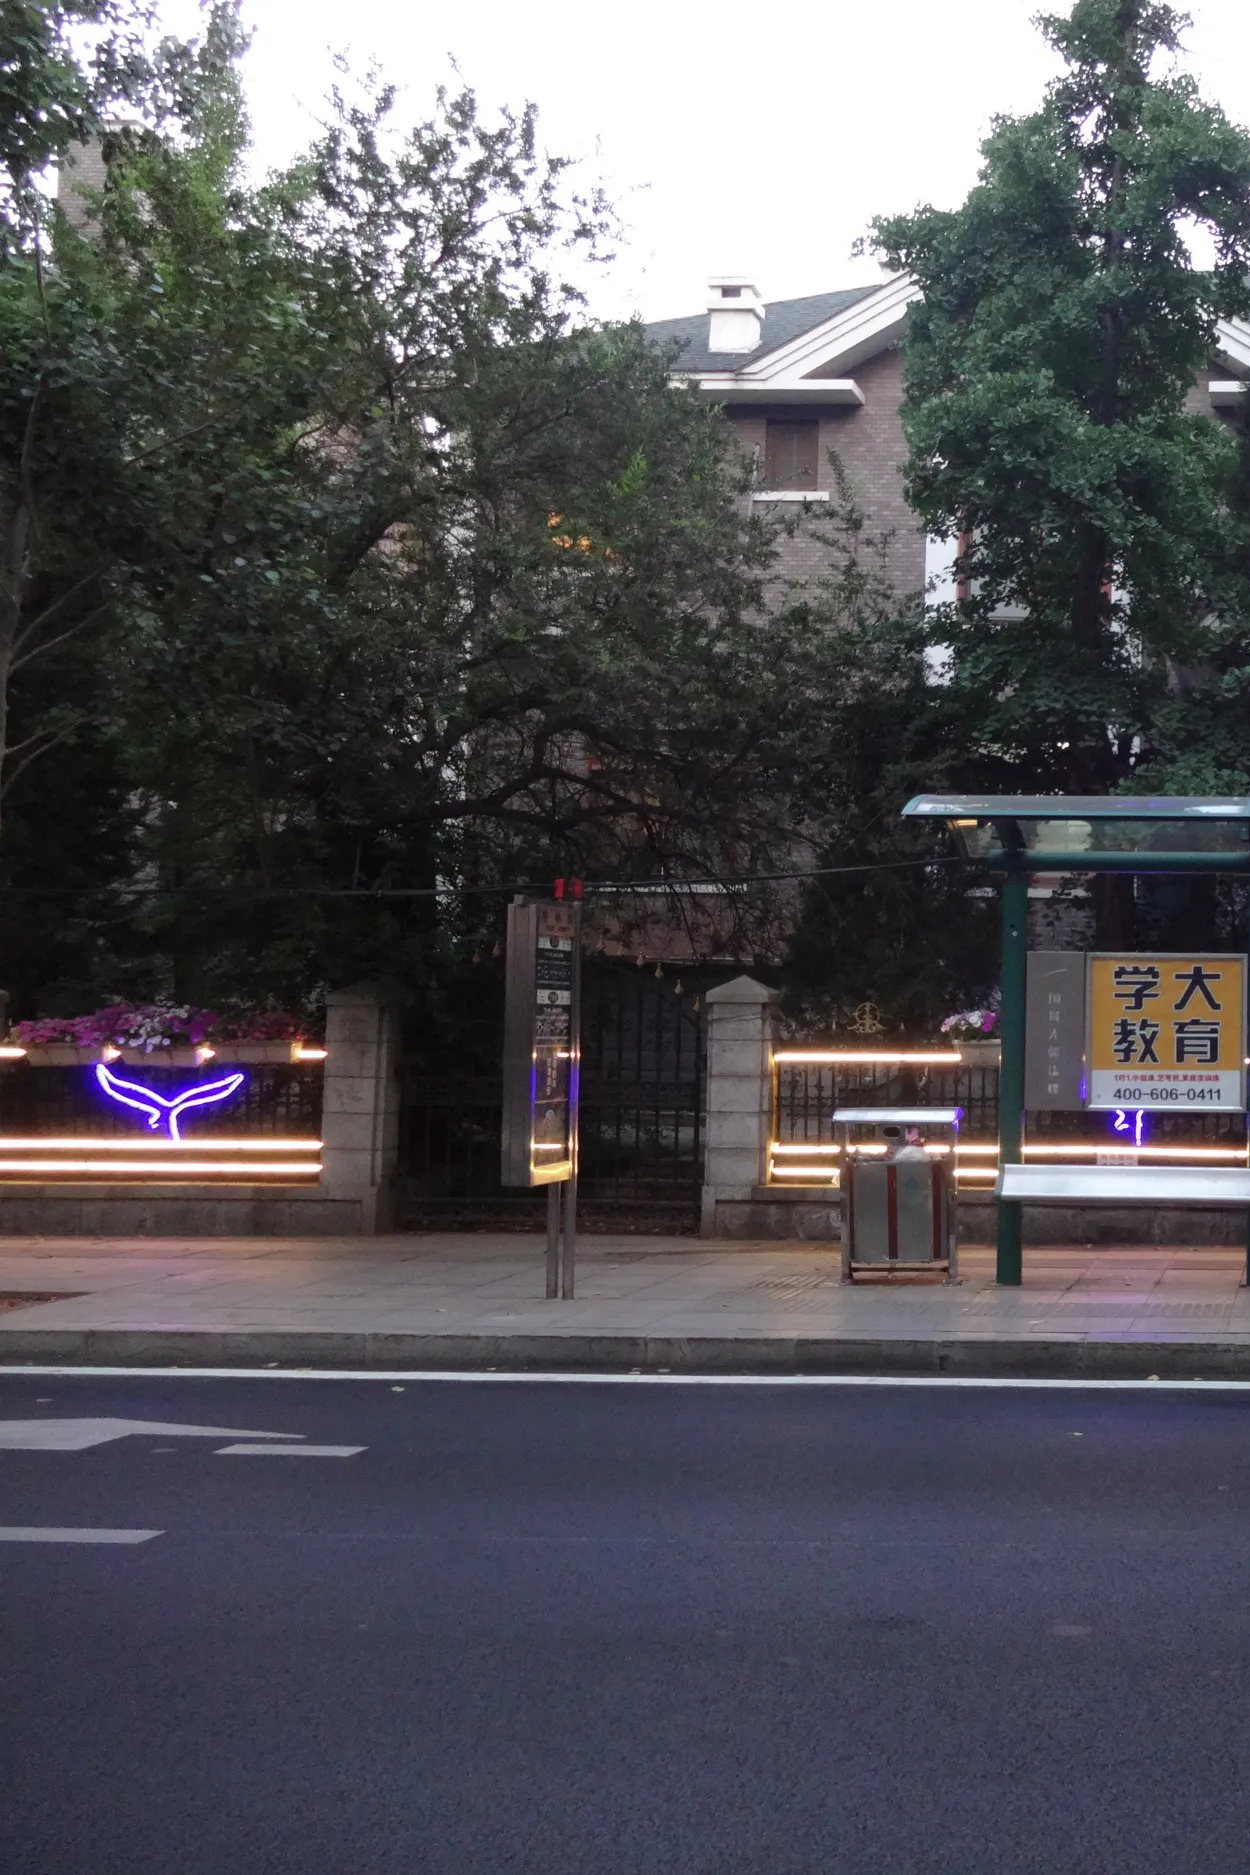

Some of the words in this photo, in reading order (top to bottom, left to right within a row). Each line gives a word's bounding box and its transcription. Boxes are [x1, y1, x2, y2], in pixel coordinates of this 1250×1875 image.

[1113, 966, 1222, 1011] 学大
[1113, 1018, 1221, 1064] 教育
[1113, 1088, 1221, 1101] 400-606-0411
